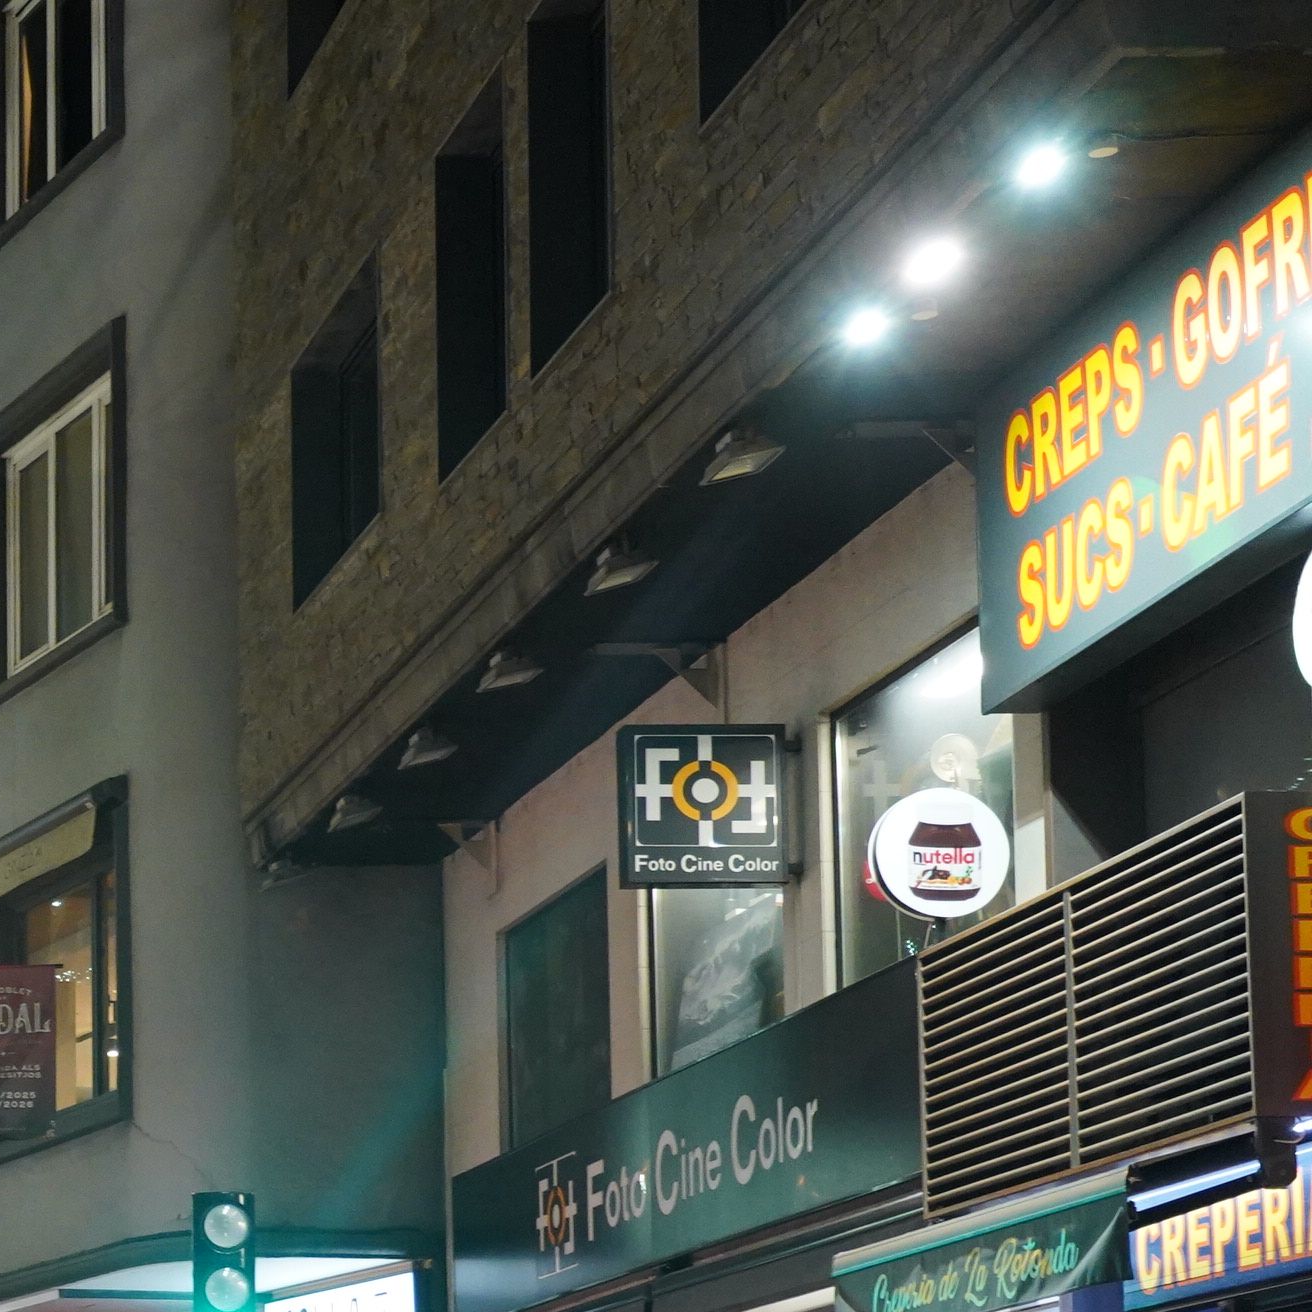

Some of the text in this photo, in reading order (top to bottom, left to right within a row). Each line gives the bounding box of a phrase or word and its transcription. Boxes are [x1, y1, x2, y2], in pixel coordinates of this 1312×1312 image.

[1004, 170, 1312, 517] CREPS GOFR
[1017, 330, 1292, 650] SUCS CAFÉ
[634, 854, 778, 873] Foto Cine Color
[913, 847, 975, 865] nutella
[586, 1094, 818, 1242] Foto Cine Color
[1135, 1166, 1312, 1296] CREPERI
[938, 1262, 959, 1302] de
[965, 1247, 989, 1308] La
[993, 1227, 1079, 1301] Rotonda
